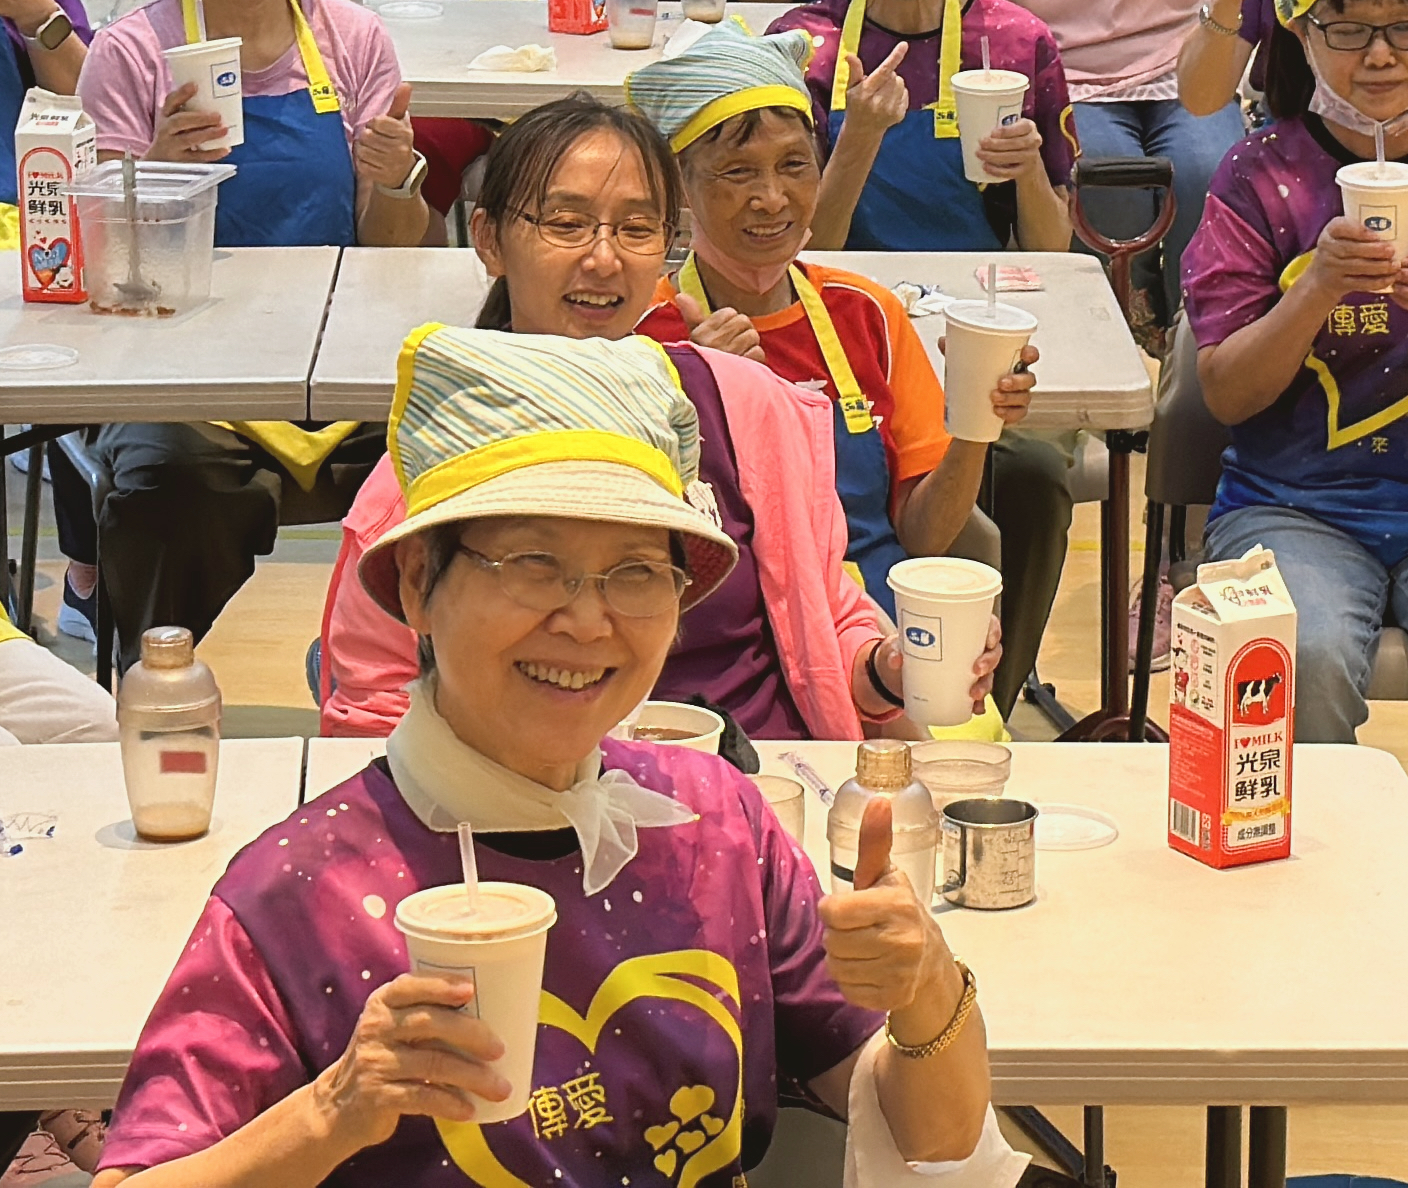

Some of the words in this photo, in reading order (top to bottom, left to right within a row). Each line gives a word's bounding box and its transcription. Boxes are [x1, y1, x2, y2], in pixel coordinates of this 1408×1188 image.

[28, 199, 66, 216] 鮮乳
[1328, 302, 1391, 336] 傳愛
[1252, 731, 1283, 747] MILK
[1236, 748, 1282, 776] 光泉
[1234, 774, 1281, 802] 鮮乳
[529, 1072, 614, 1140] 傳愛
